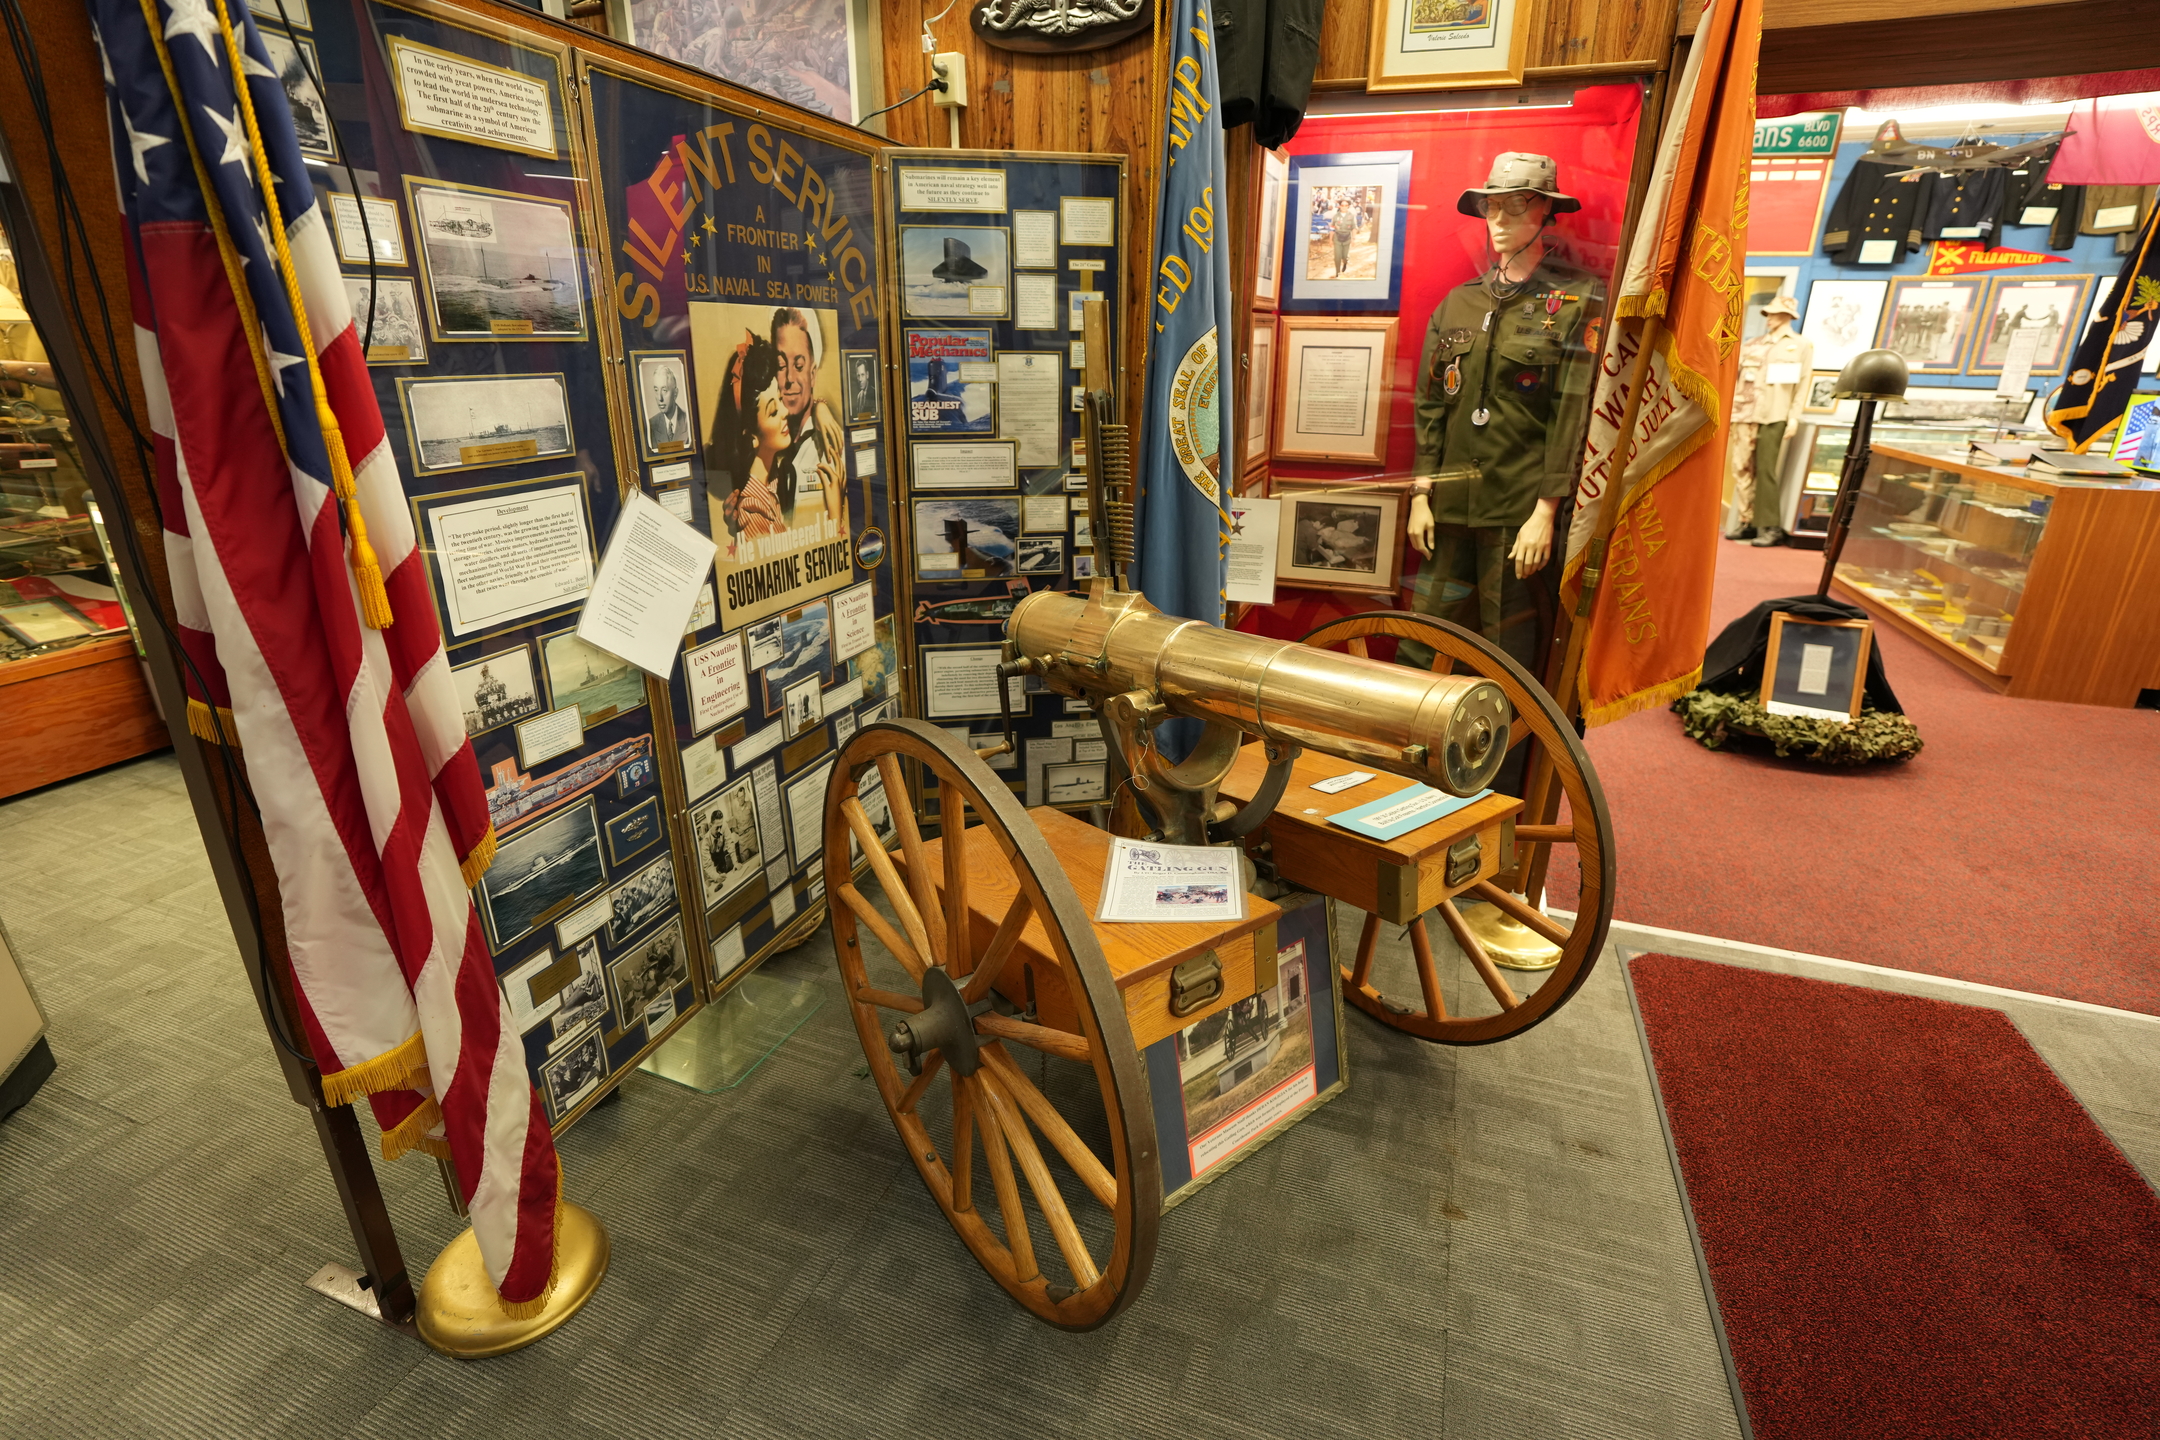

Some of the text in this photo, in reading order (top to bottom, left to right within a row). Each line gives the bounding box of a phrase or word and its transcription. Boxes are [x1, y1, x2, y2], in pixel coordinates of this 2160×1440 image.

[413, 55, 422, 64] In
[423, 59, 435, 68] the
[436, 63, 453, 74] early
[455, 69, 475, 79] years,
[476, 74, 493, 83] when
[494, 78, 504, 86] the
[505, 82, 522, 91] world
[406, 66, 543, 107] crowded with great powers, America sought
[417, 89, 431, 100] The
[433, 93, 448, 103] first
[449, 97, 463, 107] half
[471, 103, 482, 112] the
[483, 105, 494, 114] 20th
[496, 110, 518, 121] century
[532, 118, 541, 126] the
[422, 80, 438, 90] lead
[439, 85, 450, 93] the
[451, 89, 470, 98] world
[471, 92, 479, 100] in
[479, 96, 508, 107] undersea
[509, 102, 540, 116] technology.
[426, 105, 463, 117] submarine
[478, 117, 501, 126] symbol
[509, 122, 537, 134] American
[1803, 120, 1831, 132] BLVD
[441, 119, 472, 131] creativity
[487, 129, 528, 142] achievements.
[1798, 134, 1829, 148] 6600
[755, 204, 765, 224] A
[616, 122, 878, 331] SILENT SERVICE
[727, 224, 799, 251] FRONTIER
[757, 255, 771, 274] IN
[1968, 251, 1998, 264] FIELD
[684, 274, 838, 304] U.S. NAVAL SEA POWER
[909, 333, 969, 347] Popular
[1534, 329, 1560, 339] ARMY
[909, 346, 988, 358] Mechanics
[1191, 344, 1208, 365] OF
[1173, 369, 1196, 409] SEAL
[1594, 364, 1661, 431] WAR
[912, 402, 960, 410] DEADLIEST
[912, 410, 939, 421] SUB
[1640, 388, 1678, 444] JULY
[1171, 417, 1195, 465] GREAT
[1194, 470, 1216, 497] THE
[496, 505, 529, 516] Development
[460, 536, 483, 545] twentieth
[521, 526, 539, 534] growing
[462, 529, 484, 539] pre-nuke
[484, 525, 502, 534] period,
[737, 530, 754, 564] He
[757, 512, 821, 559] volunteered
[824, 510, 837, 539] for
[726, 554, 801, 610] SUBMARINE
[804, 539, 850, 583] SERVICE
[837, 592, 869, 609] USS Nautilus
[846, 603, 867, 619] Frontier
[846, 627, 864, 639] Science
[694, 643, 738, 666] USS Nautilus
[701, 657, 736, 678] A Frontier
[716, 676, 724, 685] in
[701, 682, 740, 706] Engineering
